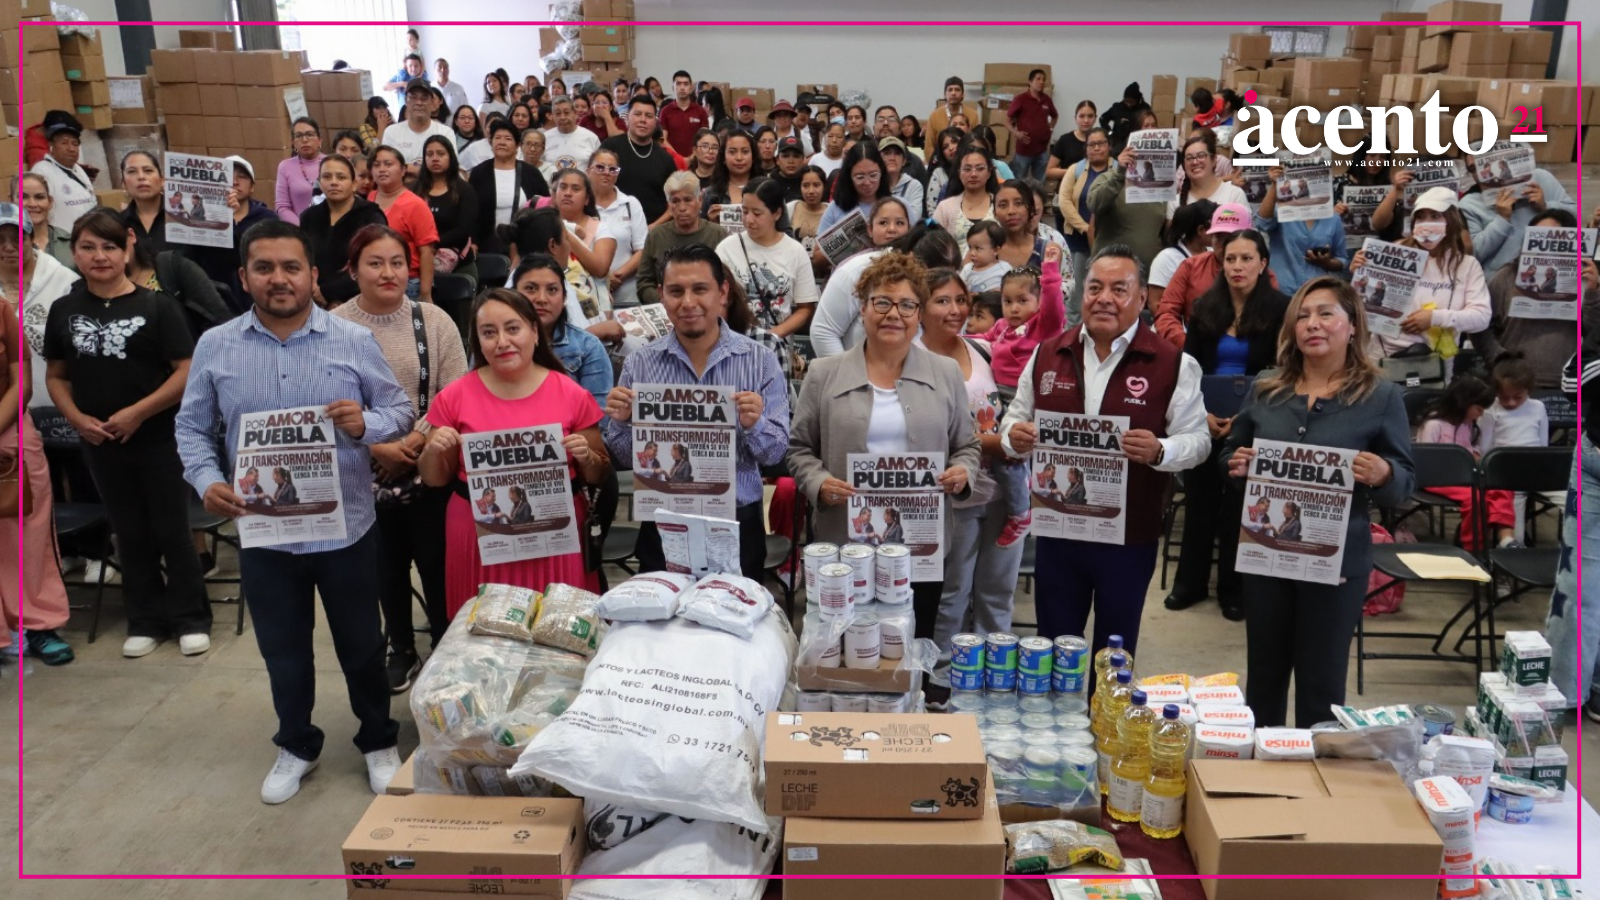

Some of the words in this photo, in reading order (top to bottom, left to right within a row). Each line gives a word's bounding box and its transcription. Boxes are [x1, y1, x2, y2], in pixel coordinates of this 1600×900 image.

[186, 158, 224, 171] AMOR
[170, 166, 228, 184] PUEBLA
[1382, 246, 1418, 260] AMOR
[1528, 239, 1588, 253] PUEBLA
[638, 392, 662, 402] POR
[662, 388, 720, 404] AMOR
[719, 395, 728, 404] A
[1124, 398, 1146, 406] PUEBLA
[246, 419, 266, 430] POR
[265, 410, 318, 428] AMOR
[317, 415, 326, 424] A
[638, 402, 728, 423] PUEBLA
[1040, 418, 1062, 428] POR
[1061, 417, 1114, 434] AMOR
[1112, 426, 1121, 434] A
[244, 426, 327, 448] PUEBLA
[468, 440, 492, 450] POR
[492, 430, 547, 449] AMOR
[546, 434, 556, 444] A
[636, 429, 648, 442] LA
[650, 428, 730, 444] TRANSFORMACIÓN
[1040, 428, 1121, 450] PUEBLA
[240, 456, 249, 468] LA
[252, 450, 332, 468] TRANSFORMACIÓN
[470, 444, 559, 469] PUEBLA
[853, 461, 876, 470] POR
[876, 457, 930, 470] AMOR
[930, 462, 937, 470] A
[1036, 452, 1046, 464] LA
[1050, 454, 1124, 472] TRANSFORMACIÓN
[1258, 448, 1282, 459] POR
[1282, 446, 1342, 468] AMOR
[1340, 460, 1349, 468] A
[471, 478, 483, 490] LA
[485, 466, 565, 489] TRANSFORMACIÓN
[854, 471, 936, 488] PUEBLA
[1255, 458, 1346, 487] PUEBLA
[852, 496, 862, 508] LA
[864, 493, 939, 508] TRANSFORMACIÓN
[1250, 484, 1261, 496] LA
[1264, 486, 1347, 508] TRANSFORMACIÓN
[1522, 661, 1545, 671] LECHE
[620, 680, 644, 688] RFC:
[634, 668, 680, 680] LACTEOS
[682, 675, 732, 687] INGLOBAL
[883, 738, 932, 746] LECHE
[1200, 730, 1247, 739] minsa
[684, 737, 698, 746] 33
[704, 741, 732, 753] 1721
[1265, 739, 1310, 749] minsa
[1206, 749, 1239, 758] minsa
[1538, 770, 1562, 778] LECHE
[781, 783, 818, 793] LECHE
[1422, 780, 1450, 807] minsa
[781, 794, 817, 812] DIF
[1445, 820, 1469, 828] minsa
[469, 883, 504, 894] LECHE
